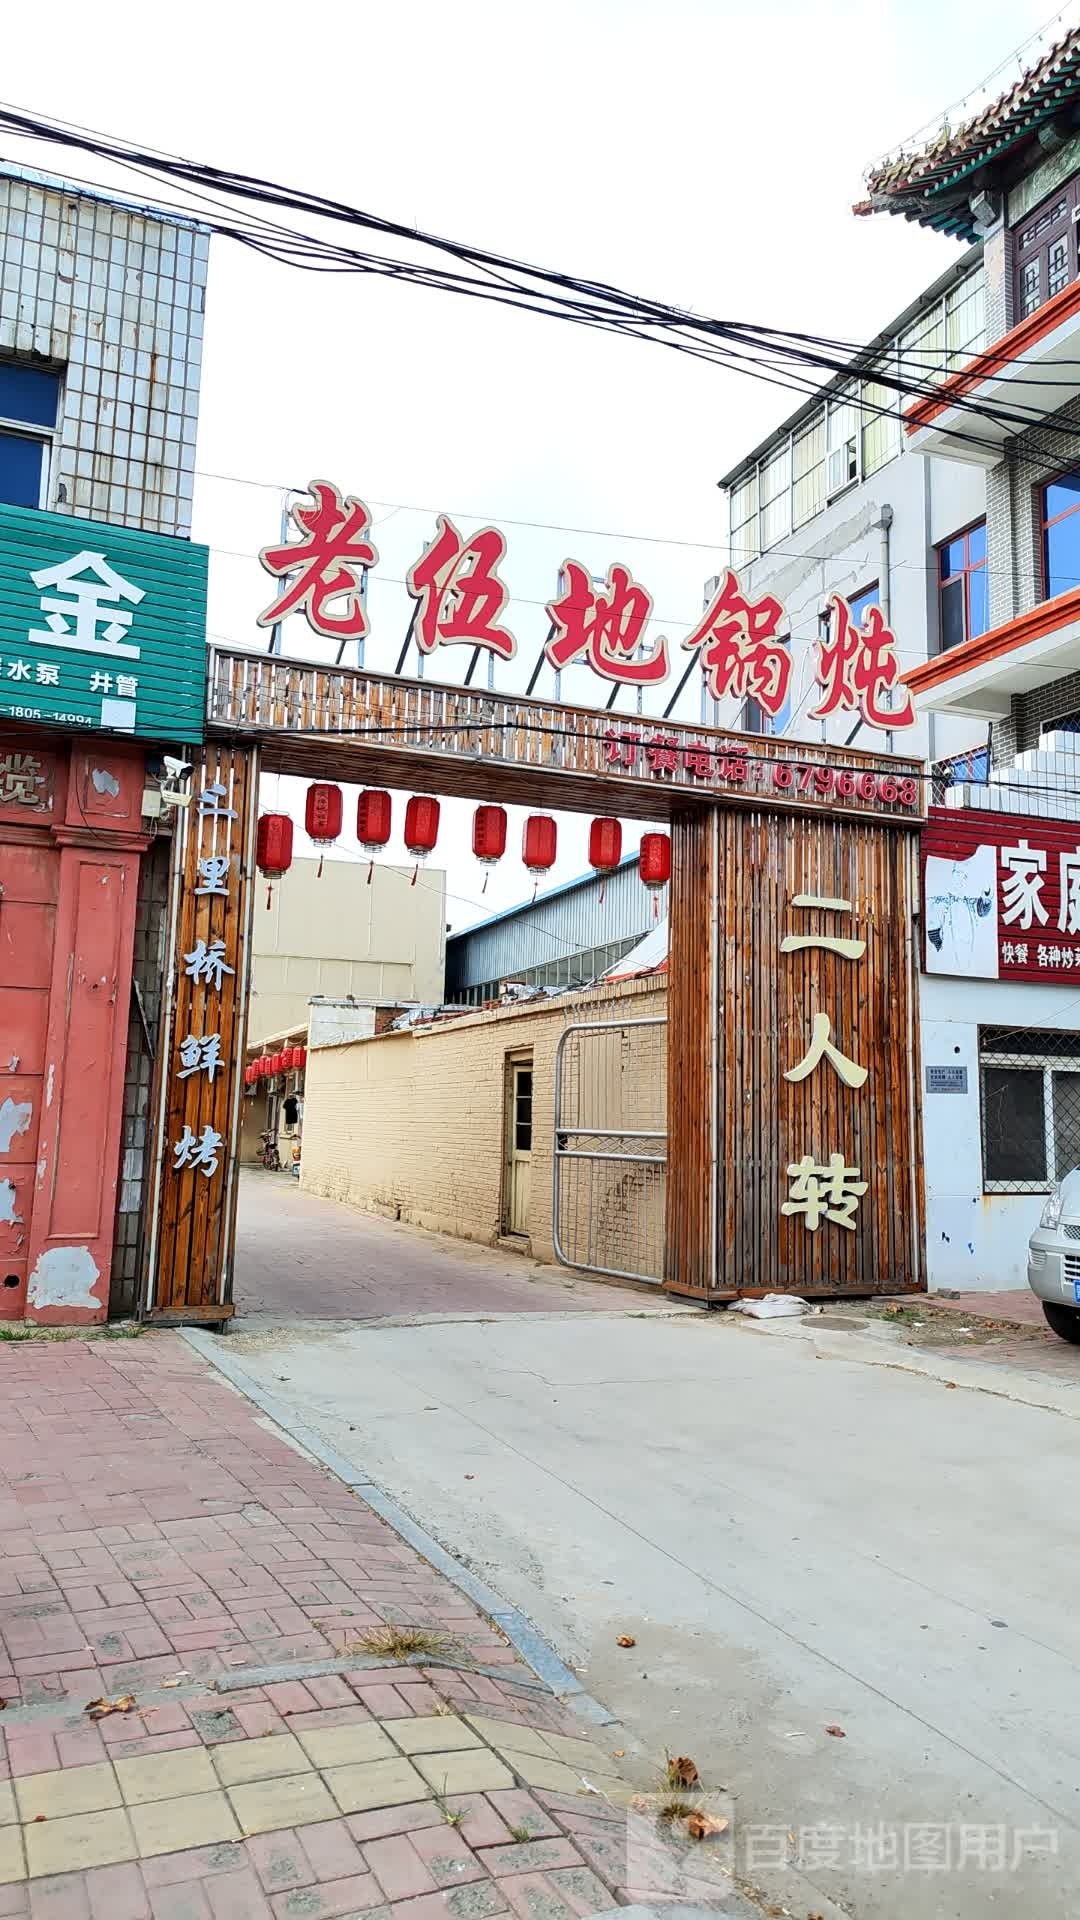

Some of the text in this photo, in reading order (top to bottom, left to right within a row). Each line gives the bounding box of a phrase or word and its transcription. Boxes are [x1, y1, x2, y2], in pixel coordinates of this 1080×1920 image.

[29, 550, 147, 660] 金
[258, 479, 916, 731] 老伍地锅炖
[0, 658, 139, 698] 水泵 井管
[1001, 941, 1029, 965] 快餐
[780, 894, 869, 1232] 二人转
